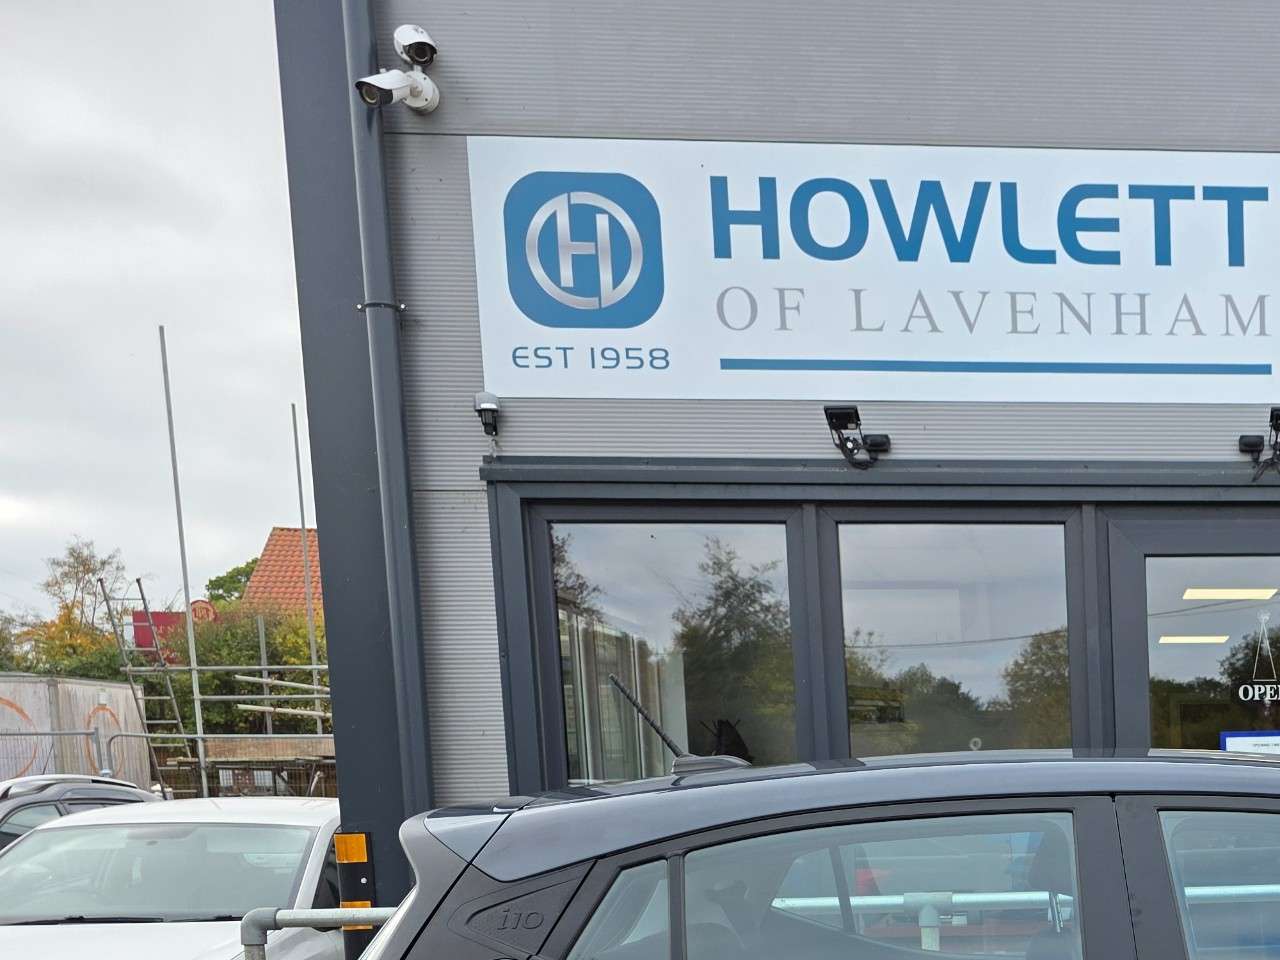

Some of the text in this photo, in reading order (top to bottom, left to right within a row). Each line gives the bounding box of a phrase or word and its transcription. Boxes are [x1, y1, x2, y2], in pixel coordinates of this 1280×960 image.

[710, 175, 1269, 268] HOWLETT
[716, 286, 1270, 337] OF LAVENHAM
[511, 346, 670, 370] EST 1958
